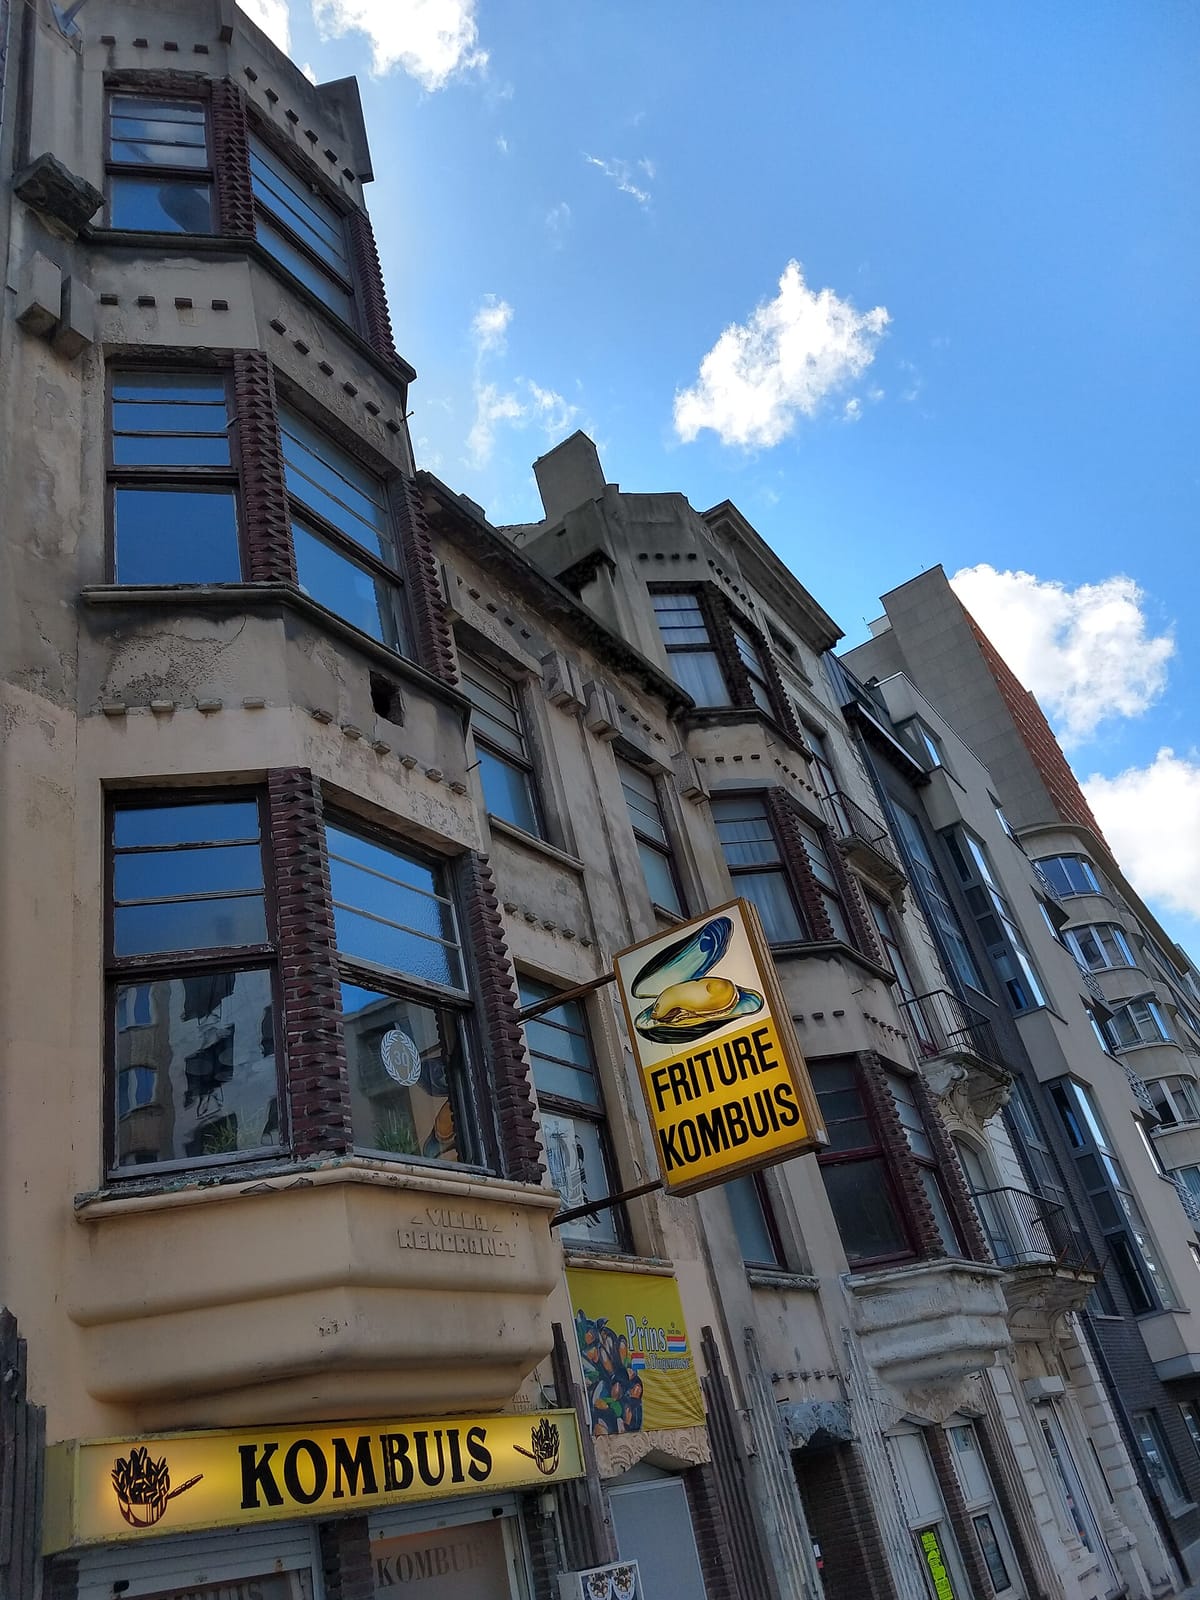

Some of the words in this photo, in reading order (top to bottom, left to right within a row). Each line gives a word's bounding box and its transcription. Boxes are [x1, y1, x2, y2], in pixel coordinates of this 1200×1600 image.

[650, 1027, 779, 1112] FRITURE
[658, 1082, 800, 1172] KOMBUIS
[425, 1207, 489, 1232] VILLA
[625, 1315, 668, 1353] Prins
[238, 1426, 493, 1510] KOMBUIS
